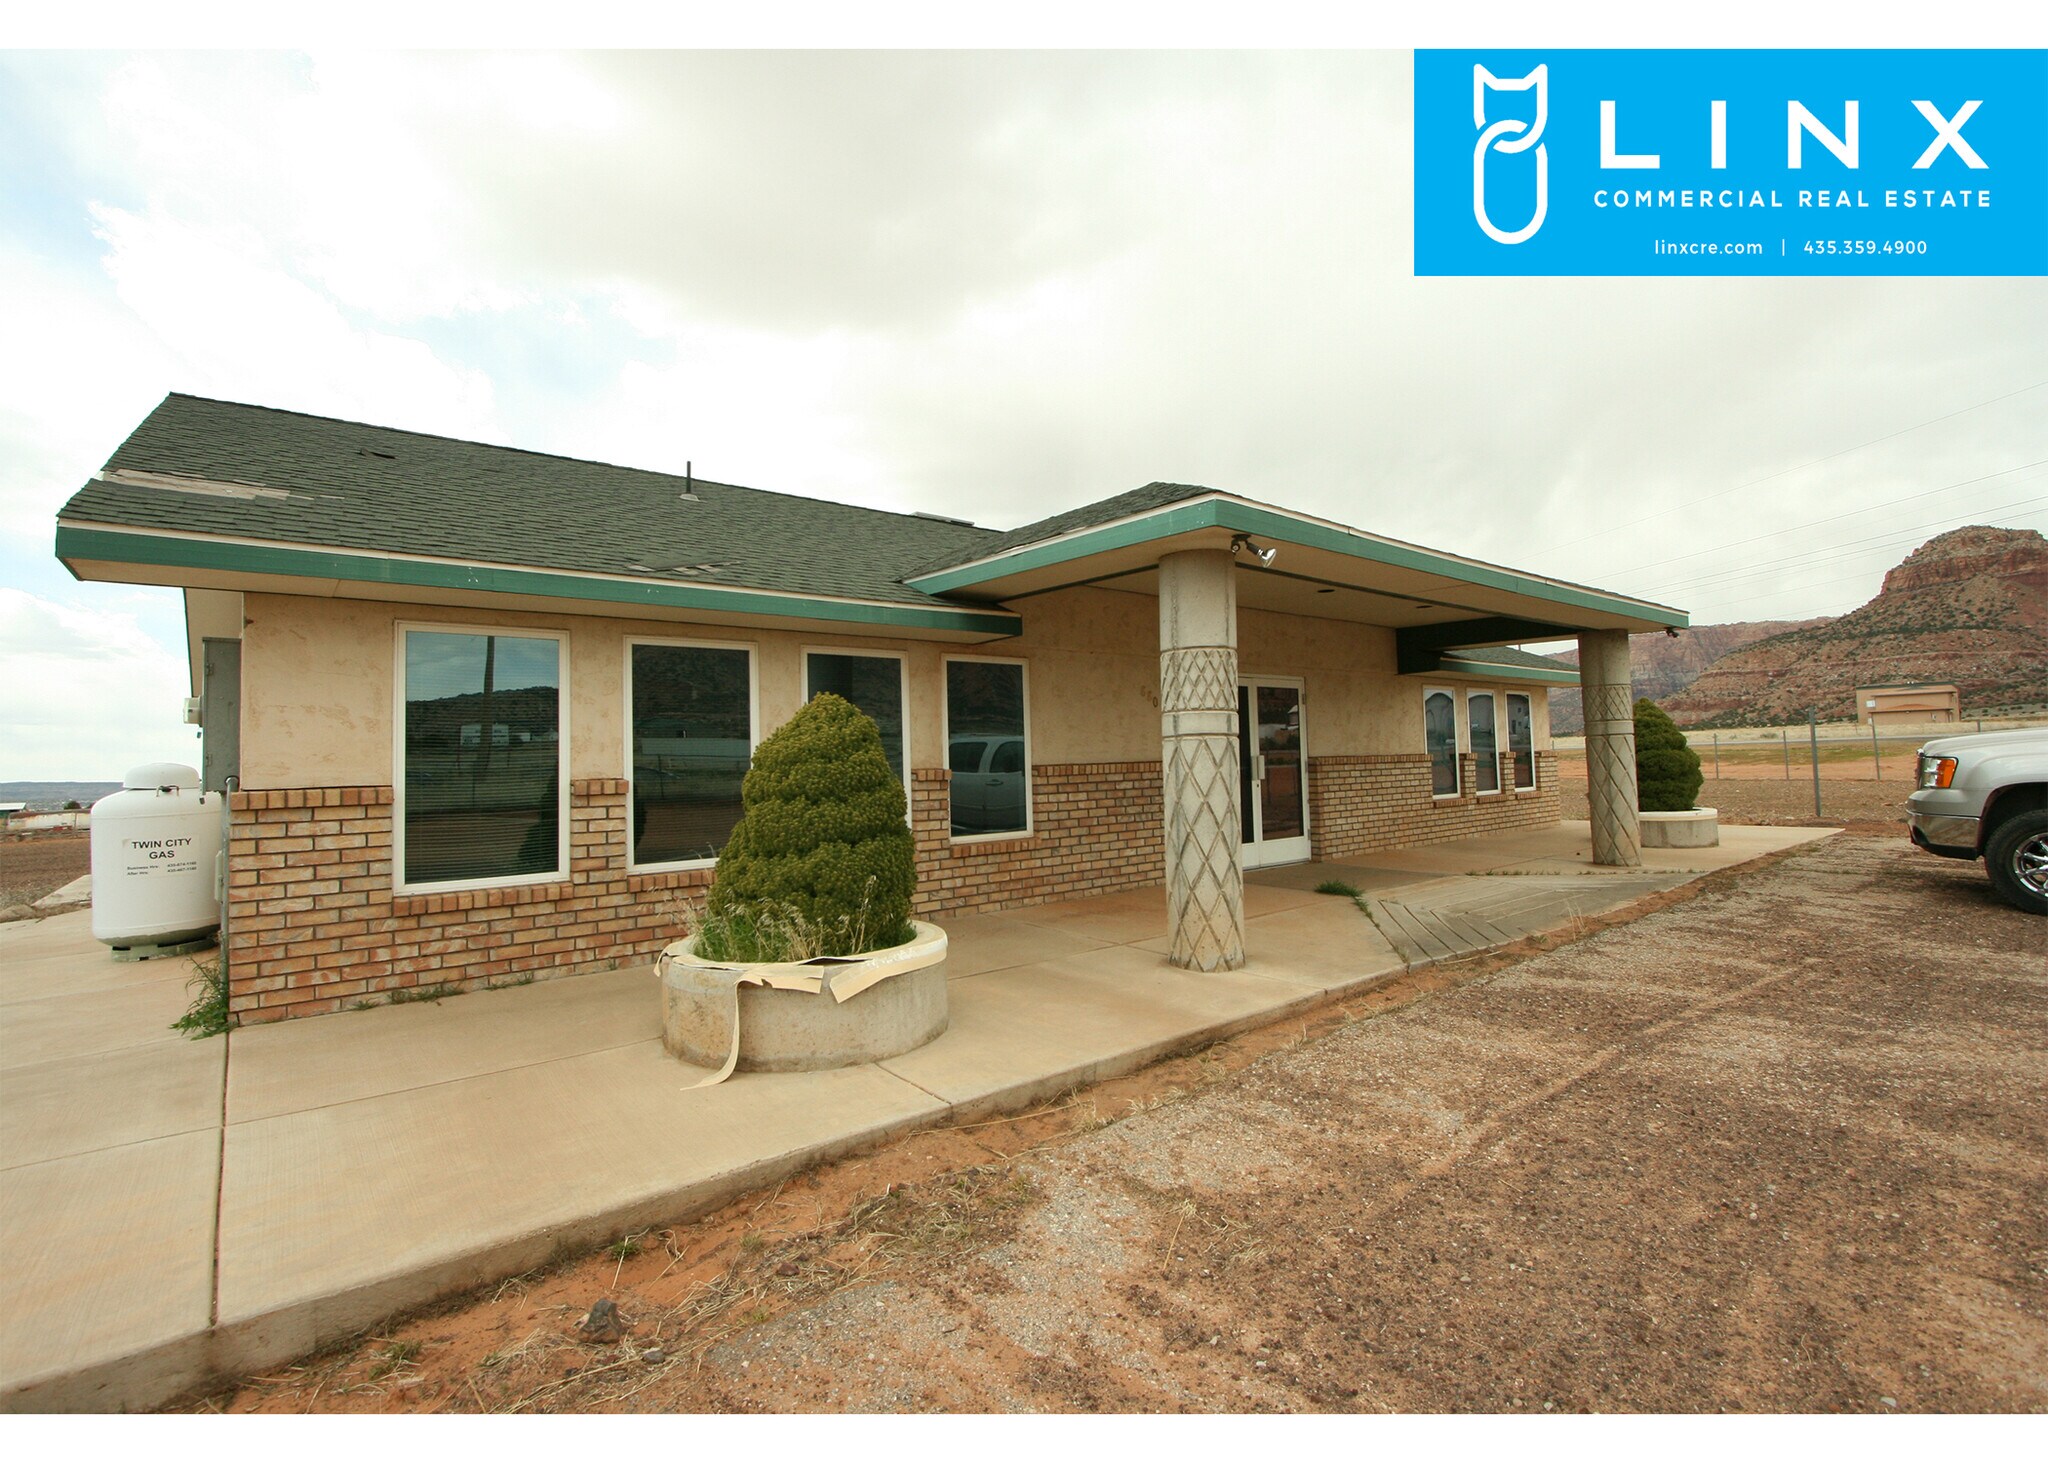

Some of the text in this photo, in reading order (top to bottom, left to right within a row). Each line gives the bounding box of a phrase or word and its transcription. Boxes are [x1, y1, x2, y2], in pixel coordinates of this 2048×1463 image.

[131, 838, 192, 849] TWIN CITY
[149, 850, 175, 860] GAS
